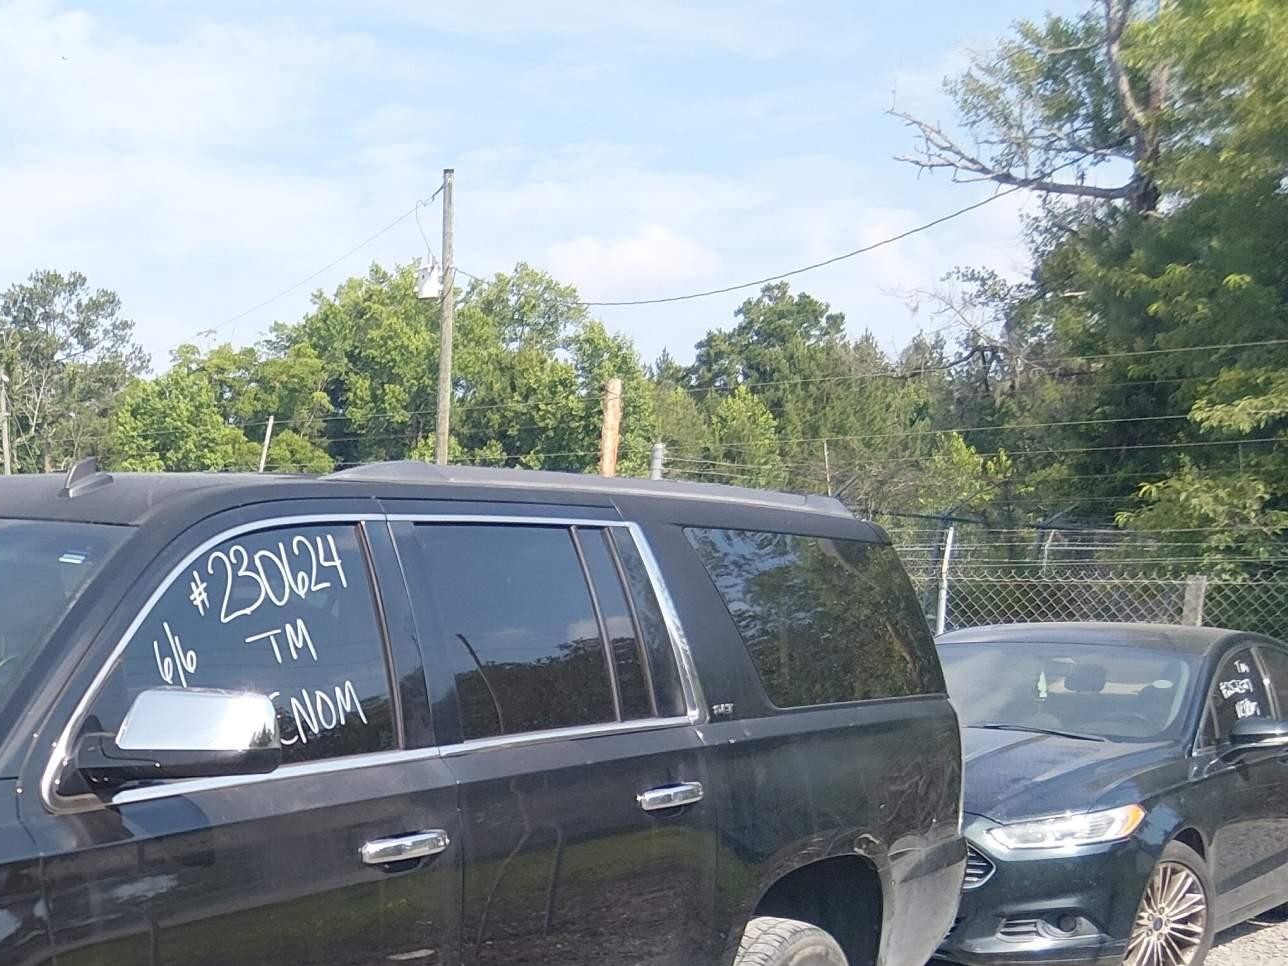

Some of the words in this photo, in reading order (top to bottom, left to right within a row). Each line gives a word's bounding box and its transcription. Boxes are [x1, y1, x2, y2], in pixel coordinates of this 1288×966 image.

[189, 533, 347, 624] #230624
[153, 622, 198, 688] 6/6
[245, 618, 318, 664] TM
